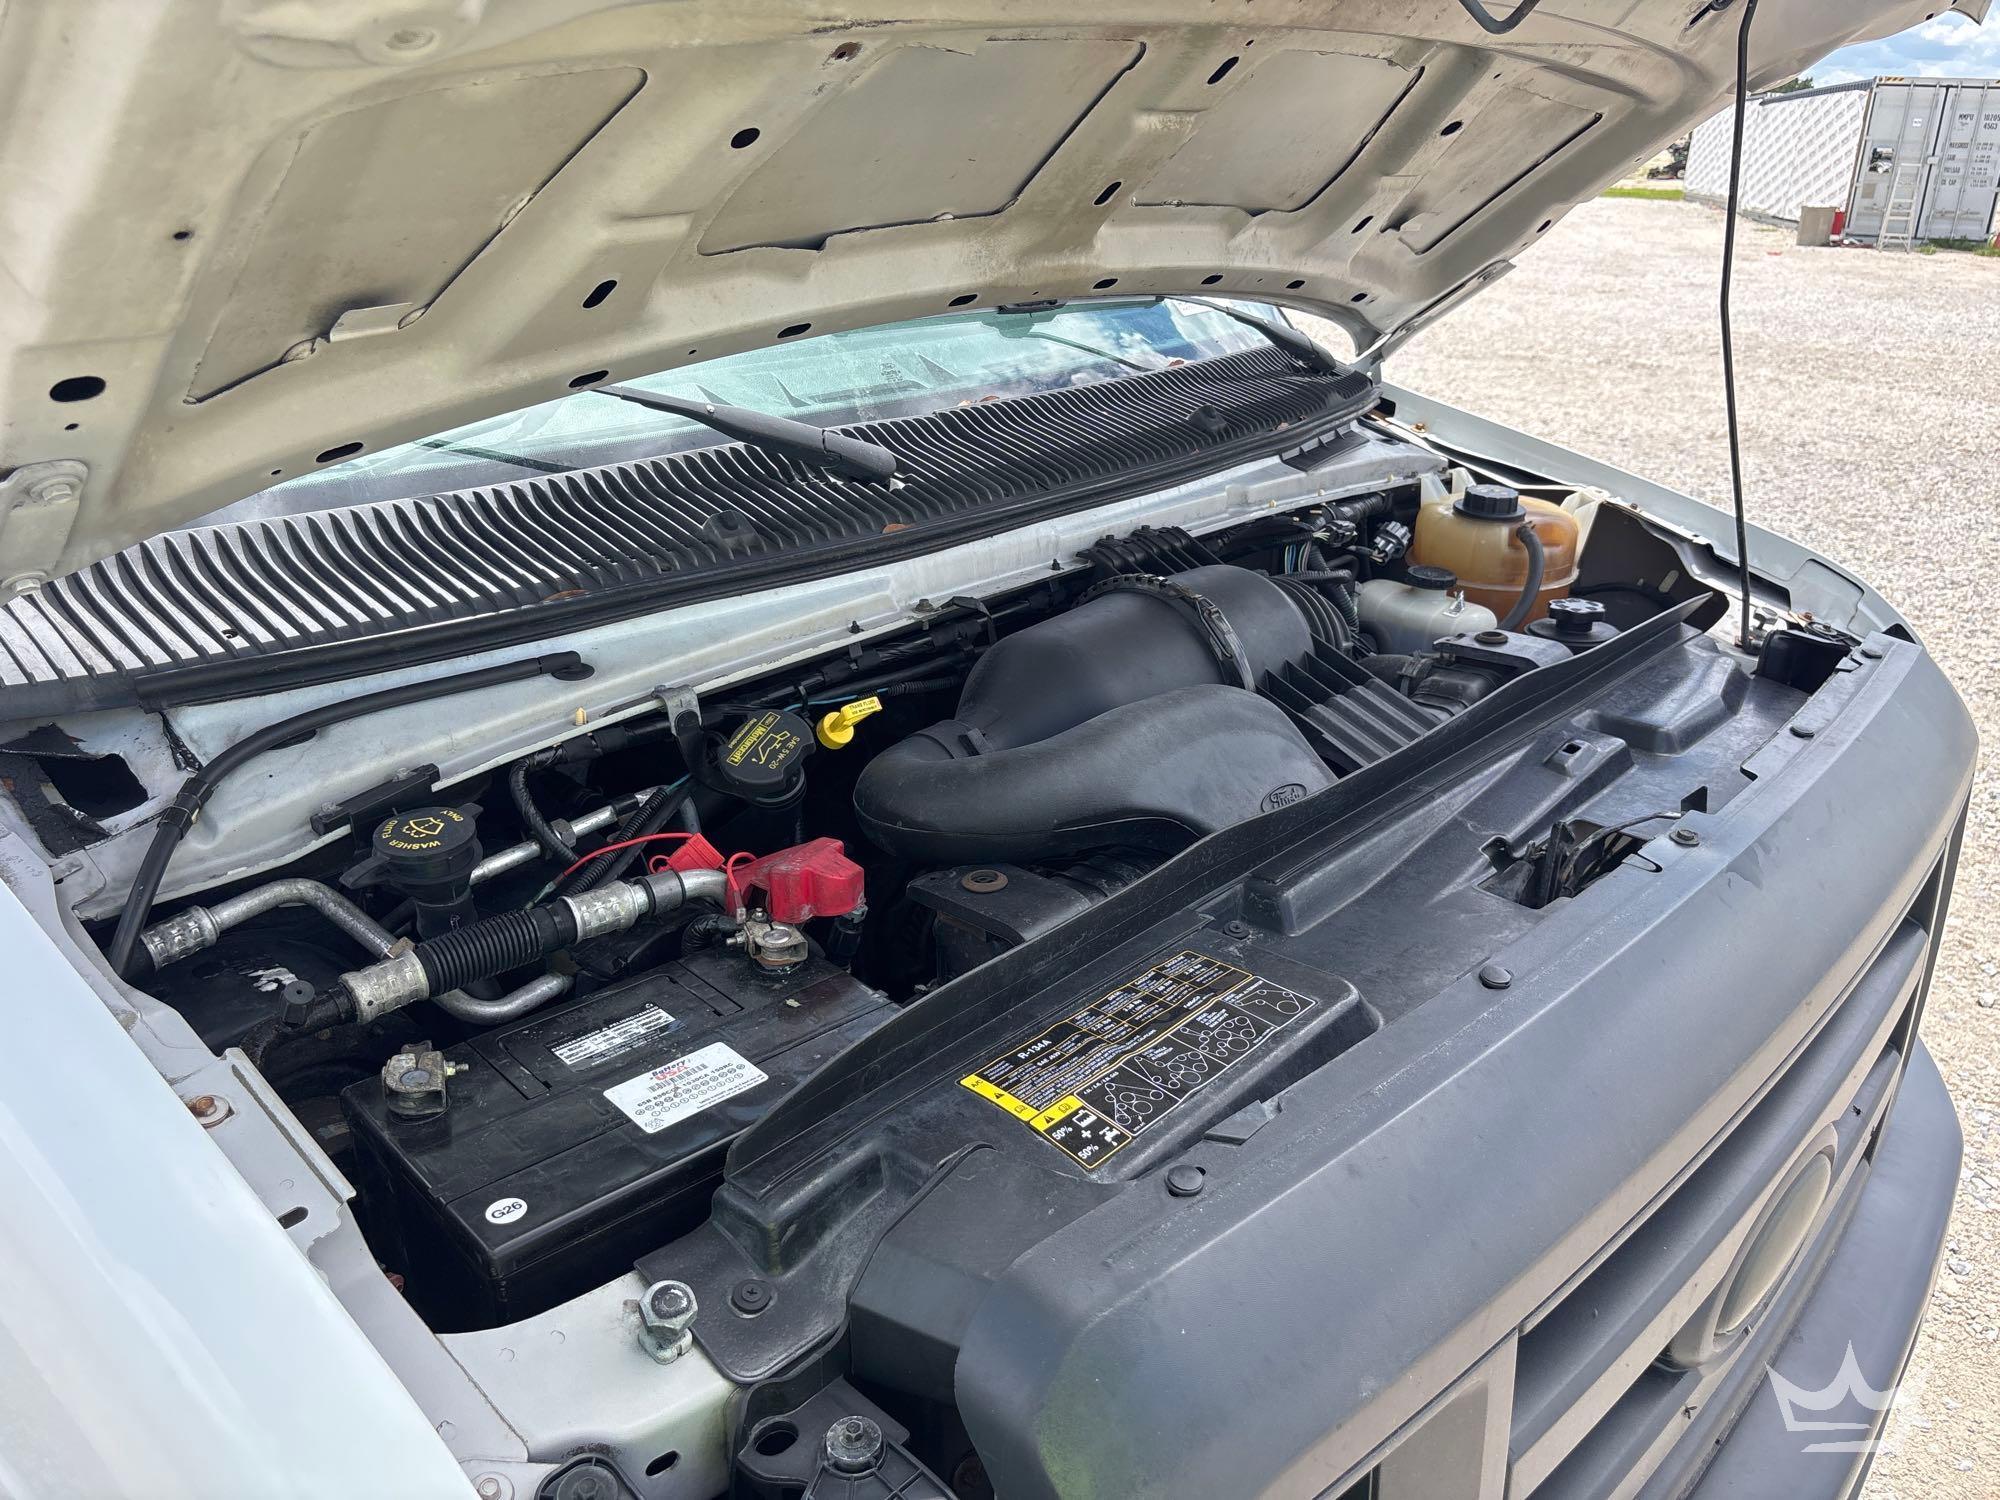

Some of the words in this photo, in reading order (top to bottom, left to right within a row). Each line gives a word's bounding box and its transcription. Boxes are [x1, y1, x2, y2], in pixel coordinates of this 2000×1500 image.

[728, 717, 758, 749] Recommended
[730, 724, 768, 763] Motorcraft
[786, 735, 801, 750] SAE
[768, 747, 790, 770] 5W-20
[440, 810, 464, 822] ONLY
[381, 820, 398, 839] FLUID
[389, 839, 442, 850] WASHER
[1016, 1038, 1052, 1059] R-134A
[969, 1078, 984, 1087] A/C
[1049, 1123, 1074, 1140] 50%
[1076, 1142, 1100, 1160] 50%
[491, 1201, 522, 1219] G26
